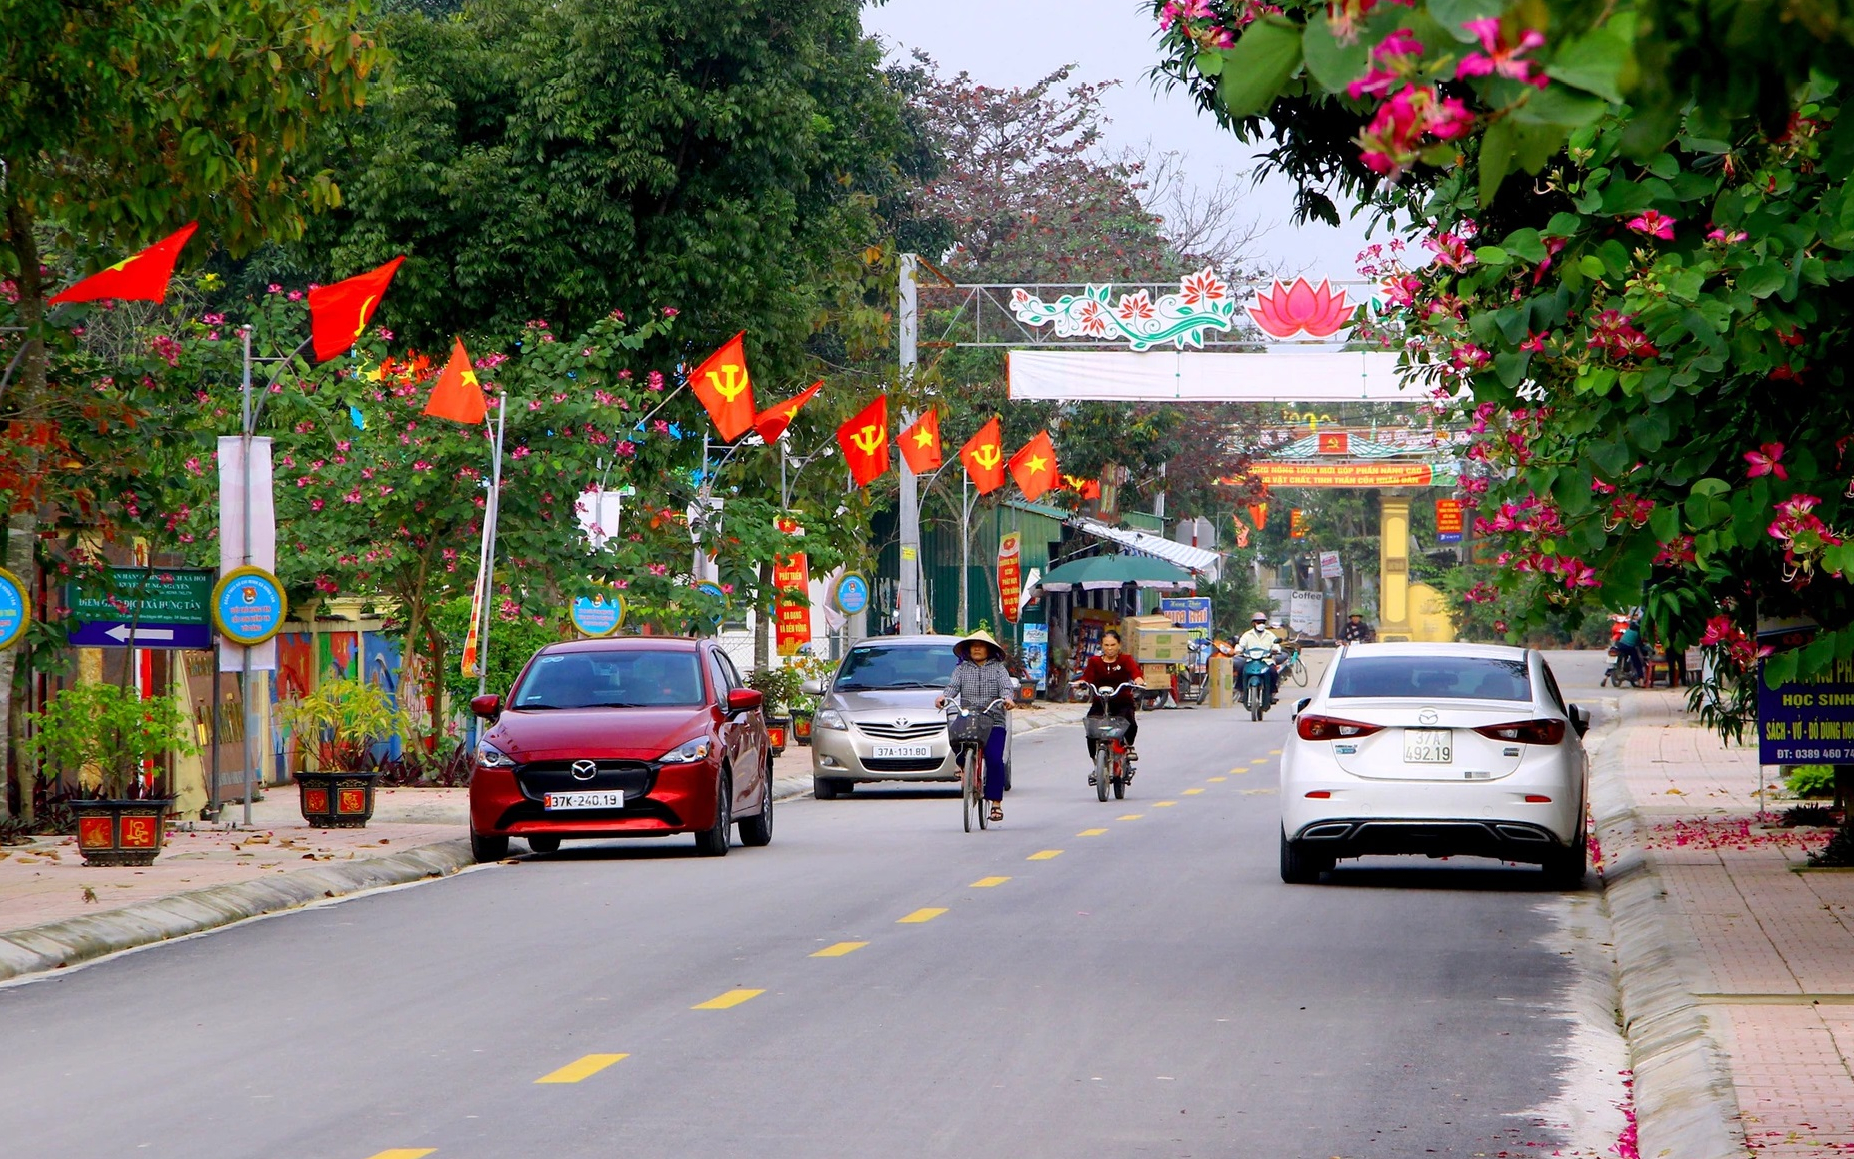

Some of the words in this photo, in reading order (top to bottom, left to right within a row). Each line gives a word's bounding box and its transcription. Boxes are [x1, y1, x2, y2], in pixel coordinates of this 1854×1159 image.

[1782, 693, 1814, 709] HỌC
[1818, 693, 1854, 706] SINH
[1766, 718, 1786, 740] SÁCH
[1792, 714, 1803, 740] VỞ
[1406, 746, 1450, 761] 492.19
[1777, 749, 1793, 759] ĐT:
[1795, 749, 1820, 759] 0389
[1823, 749, 1841, 759] 460
[552, 795, 617, 807] 37K-240.19
